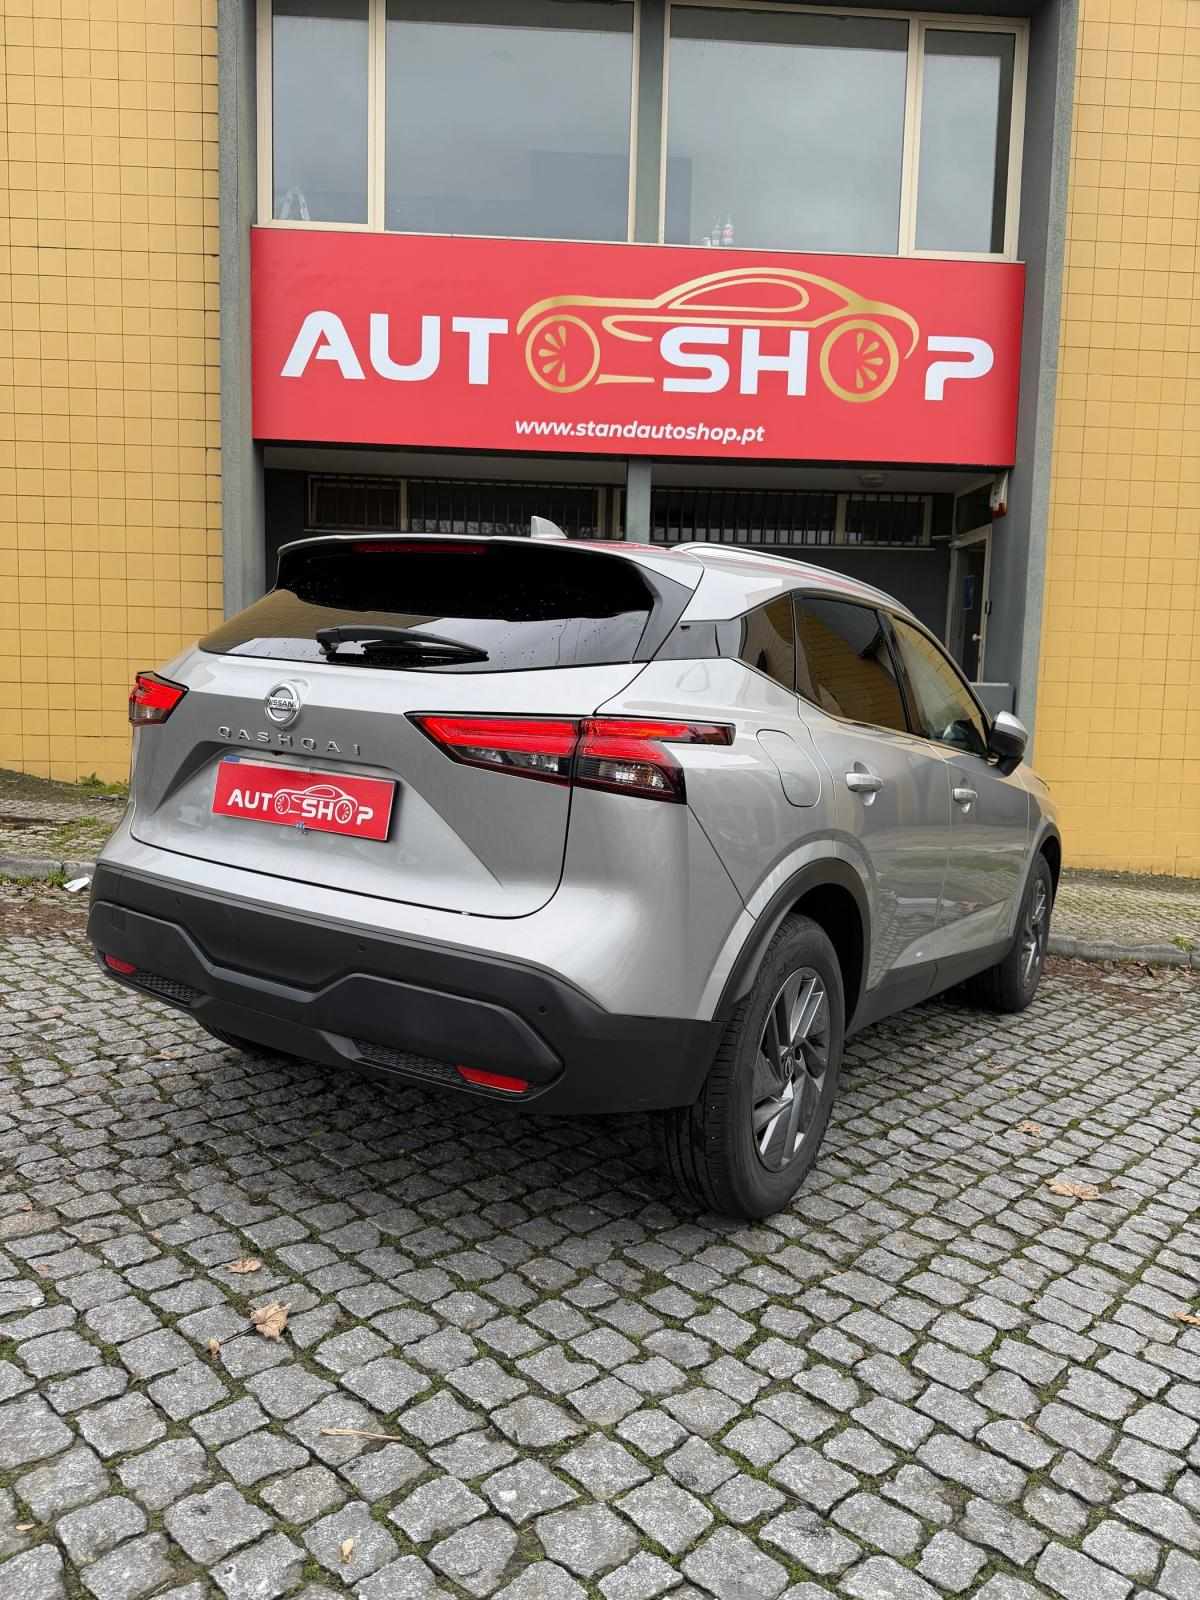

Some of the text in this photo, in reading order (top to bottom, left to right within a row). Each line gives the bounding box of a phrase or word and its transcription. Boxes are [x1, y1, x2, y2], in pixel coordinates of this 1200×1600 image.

[515, 419, 765, 445] www.standautoshop.pt
[267, 697, 297, 709] NISSAN
[217, 726, 361, 756] QASHQAI
